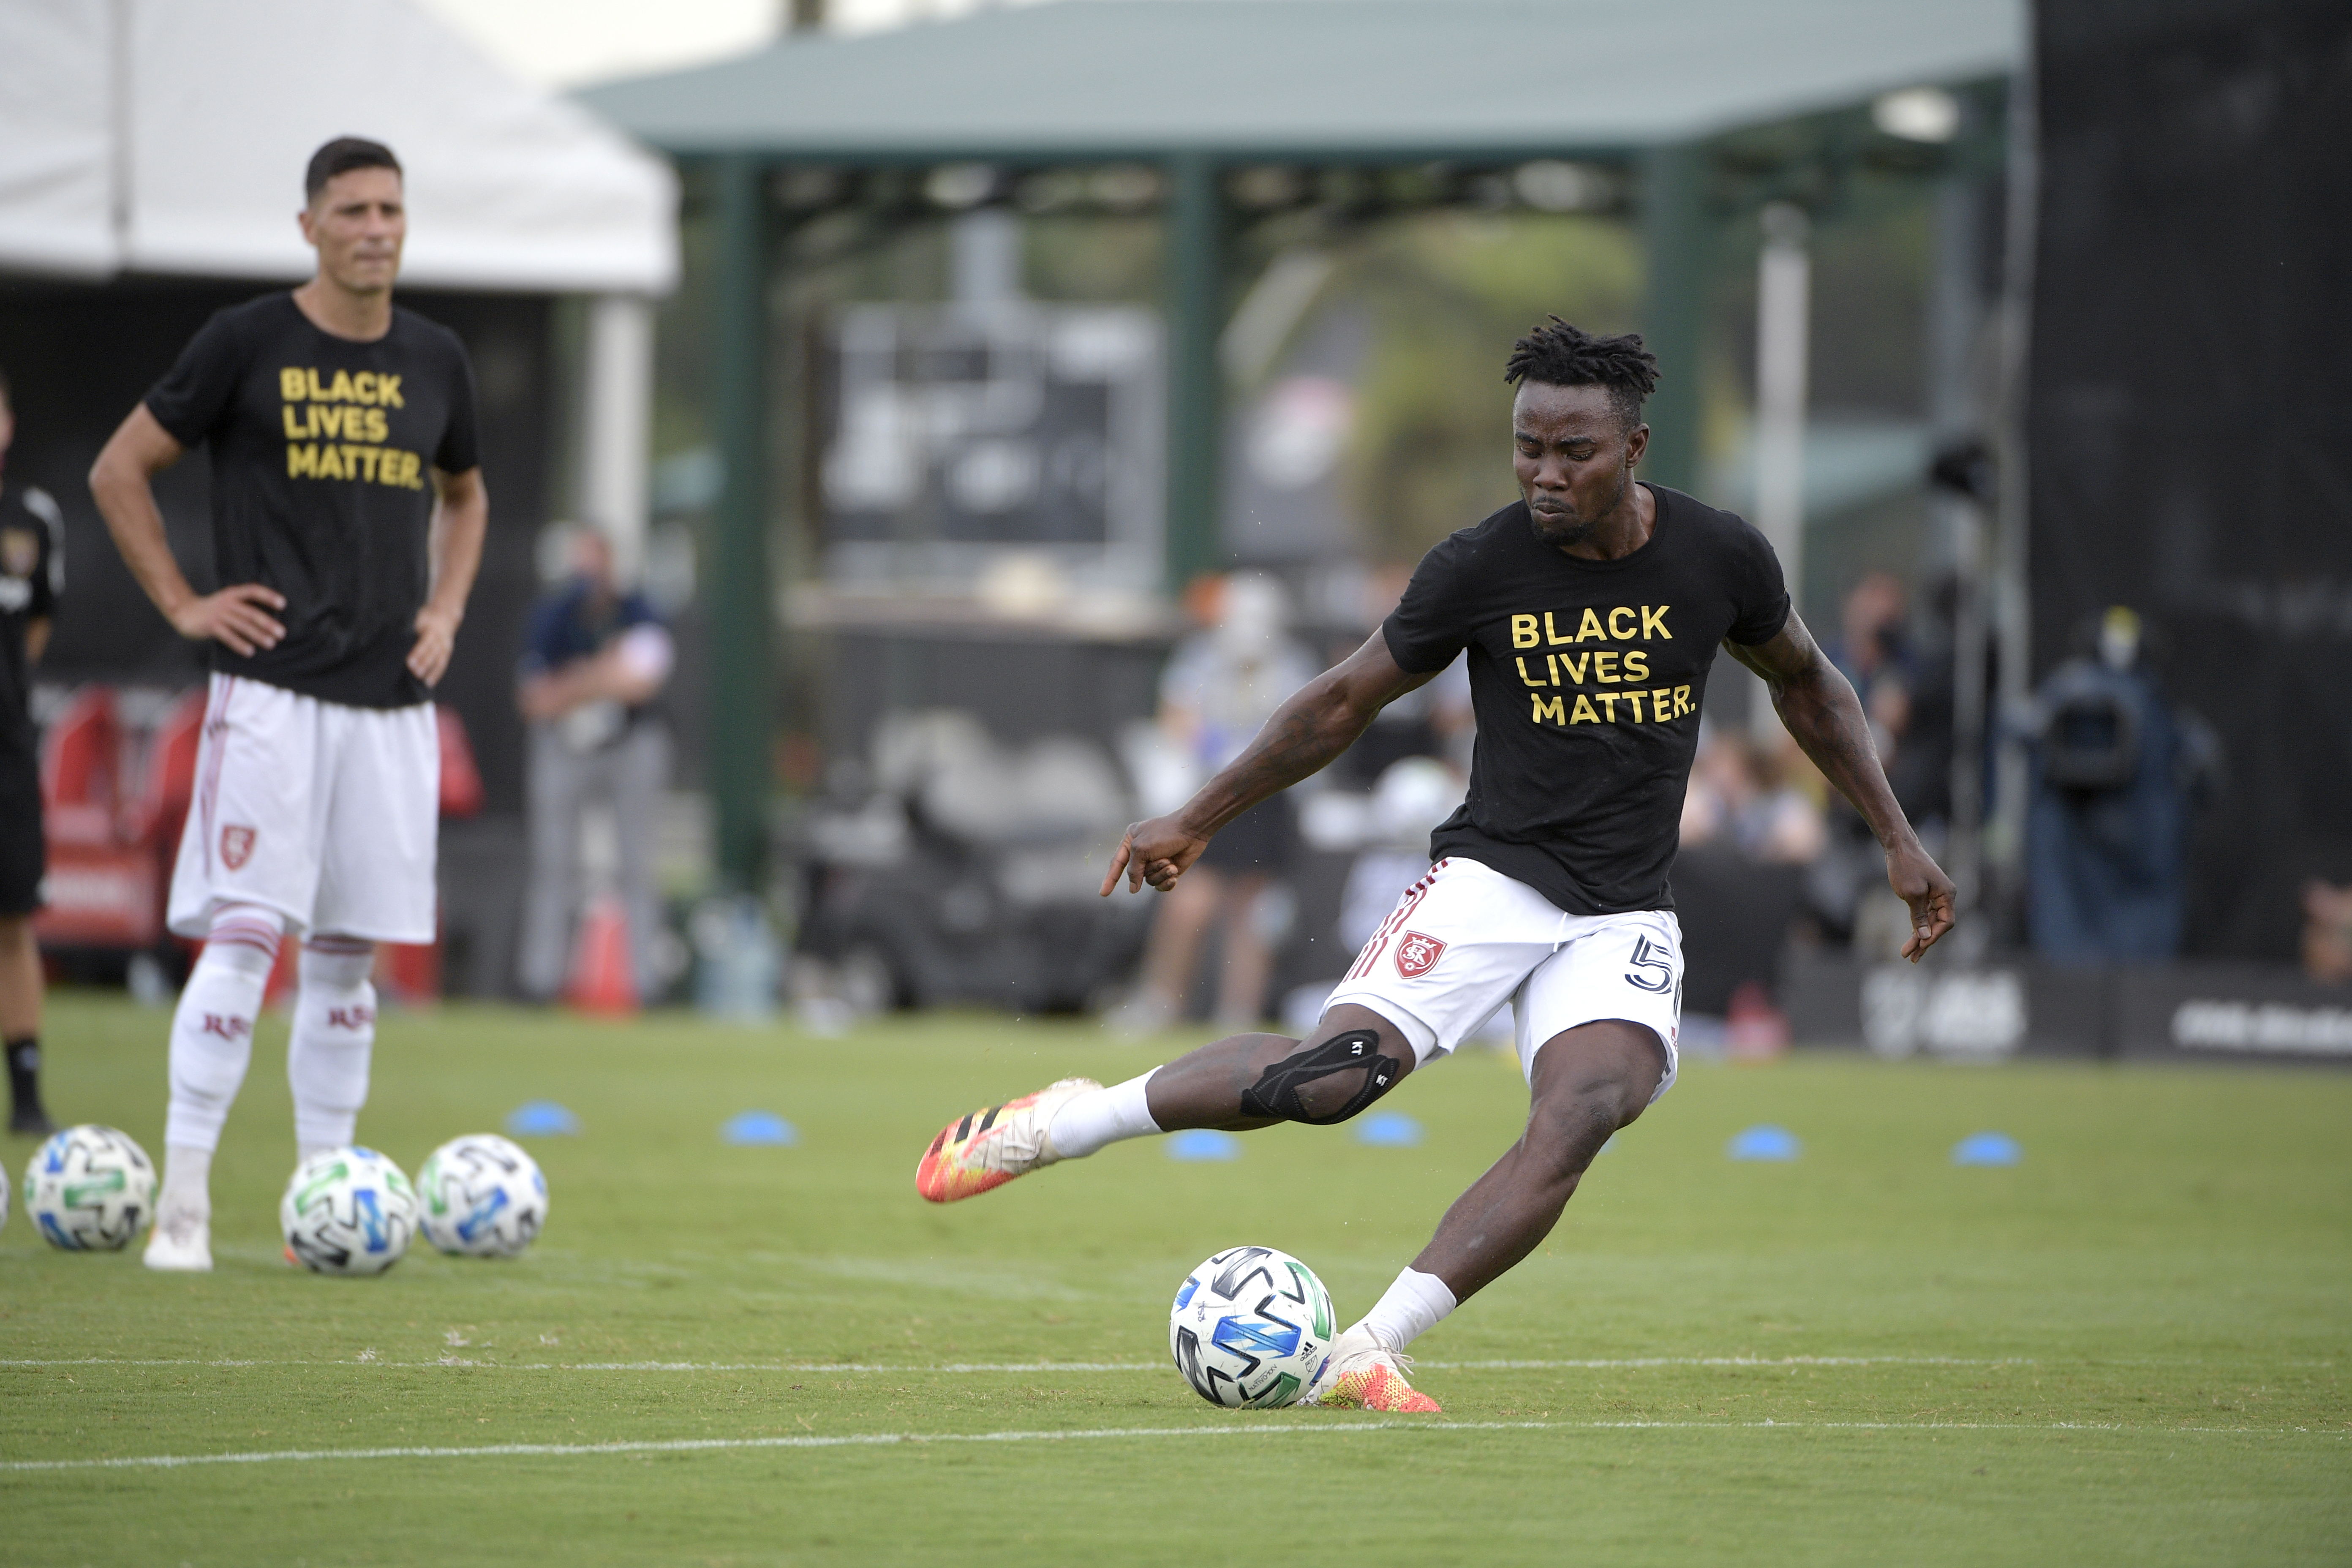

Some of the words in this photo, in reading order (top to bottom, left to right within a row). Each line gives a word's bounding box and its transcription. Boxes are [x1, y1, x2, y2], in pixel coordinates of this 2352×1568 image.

[280, 367, 405, 408] BLACK
[283, 404, 389, 442] LIVES
[286, 442, 424, 490] MATTER.
[1511, 605, 1673, 649] BLACK
[1516, 651, 1650, 686] LIVES
[1531, 684, 1696, 726] MATTER.
[1351, 1041, 1364, 1056] KT
[1375, 1074, 1388, 1087] KT
[1300, 1345, 1318, 1361] adidas
[1248, 1374, 1268, 1391] NATIVO
